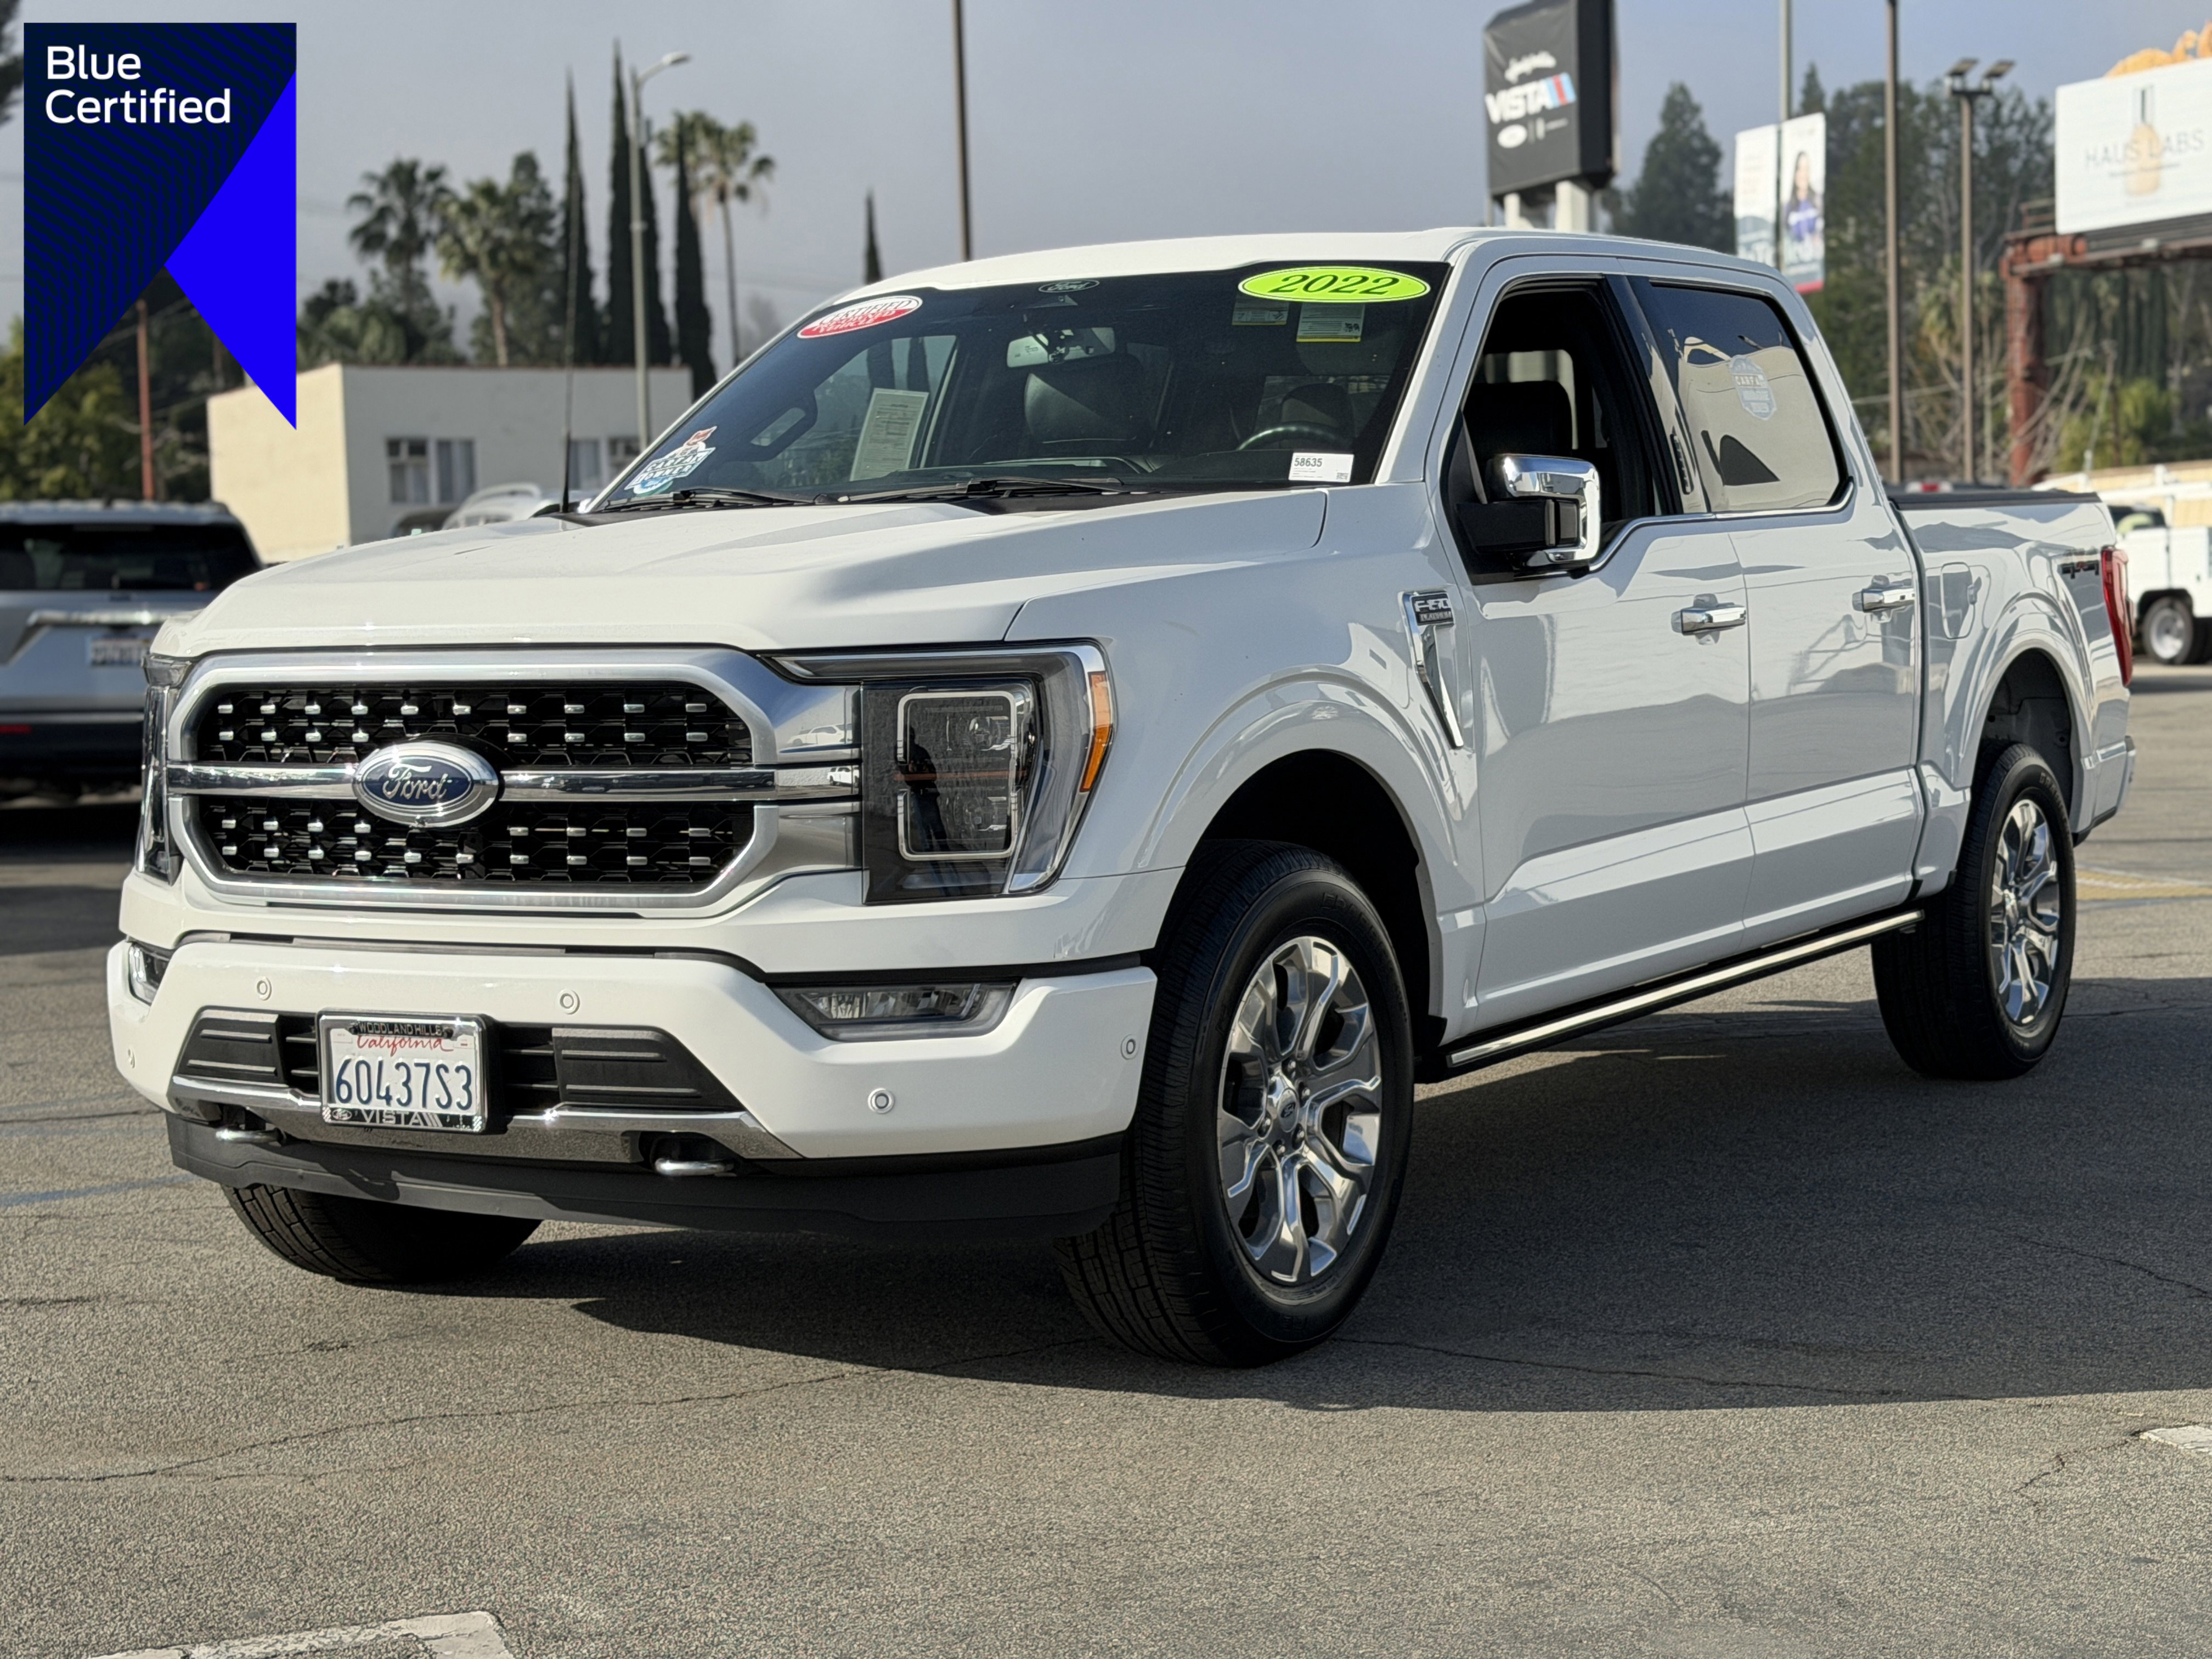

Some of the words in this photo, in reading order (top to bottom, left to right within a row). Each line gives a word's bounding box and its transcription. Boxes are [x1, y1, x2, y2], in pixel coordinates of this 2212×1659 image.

[1485, 78, 1554, 124] VISTA
[2148, 129, 2205, 159] LABS
[1267, 274, 1400, 295] 2022
[819, 300, 912, 325] CERTIFIED
[646, 453, 705, 472] CARFAX
[1294, 458, 1323, 467] 58635
[382, 763, 449, 800] Ford
[359, 1022, 414, 1035] WOODLAND
[415, 1024, 442, 1036] HILLS
[357, 1035, 454, 1057] California
[335, 1058, 473, 1111] 60437S3
[362, 1108, 426, 1127] VISTA
